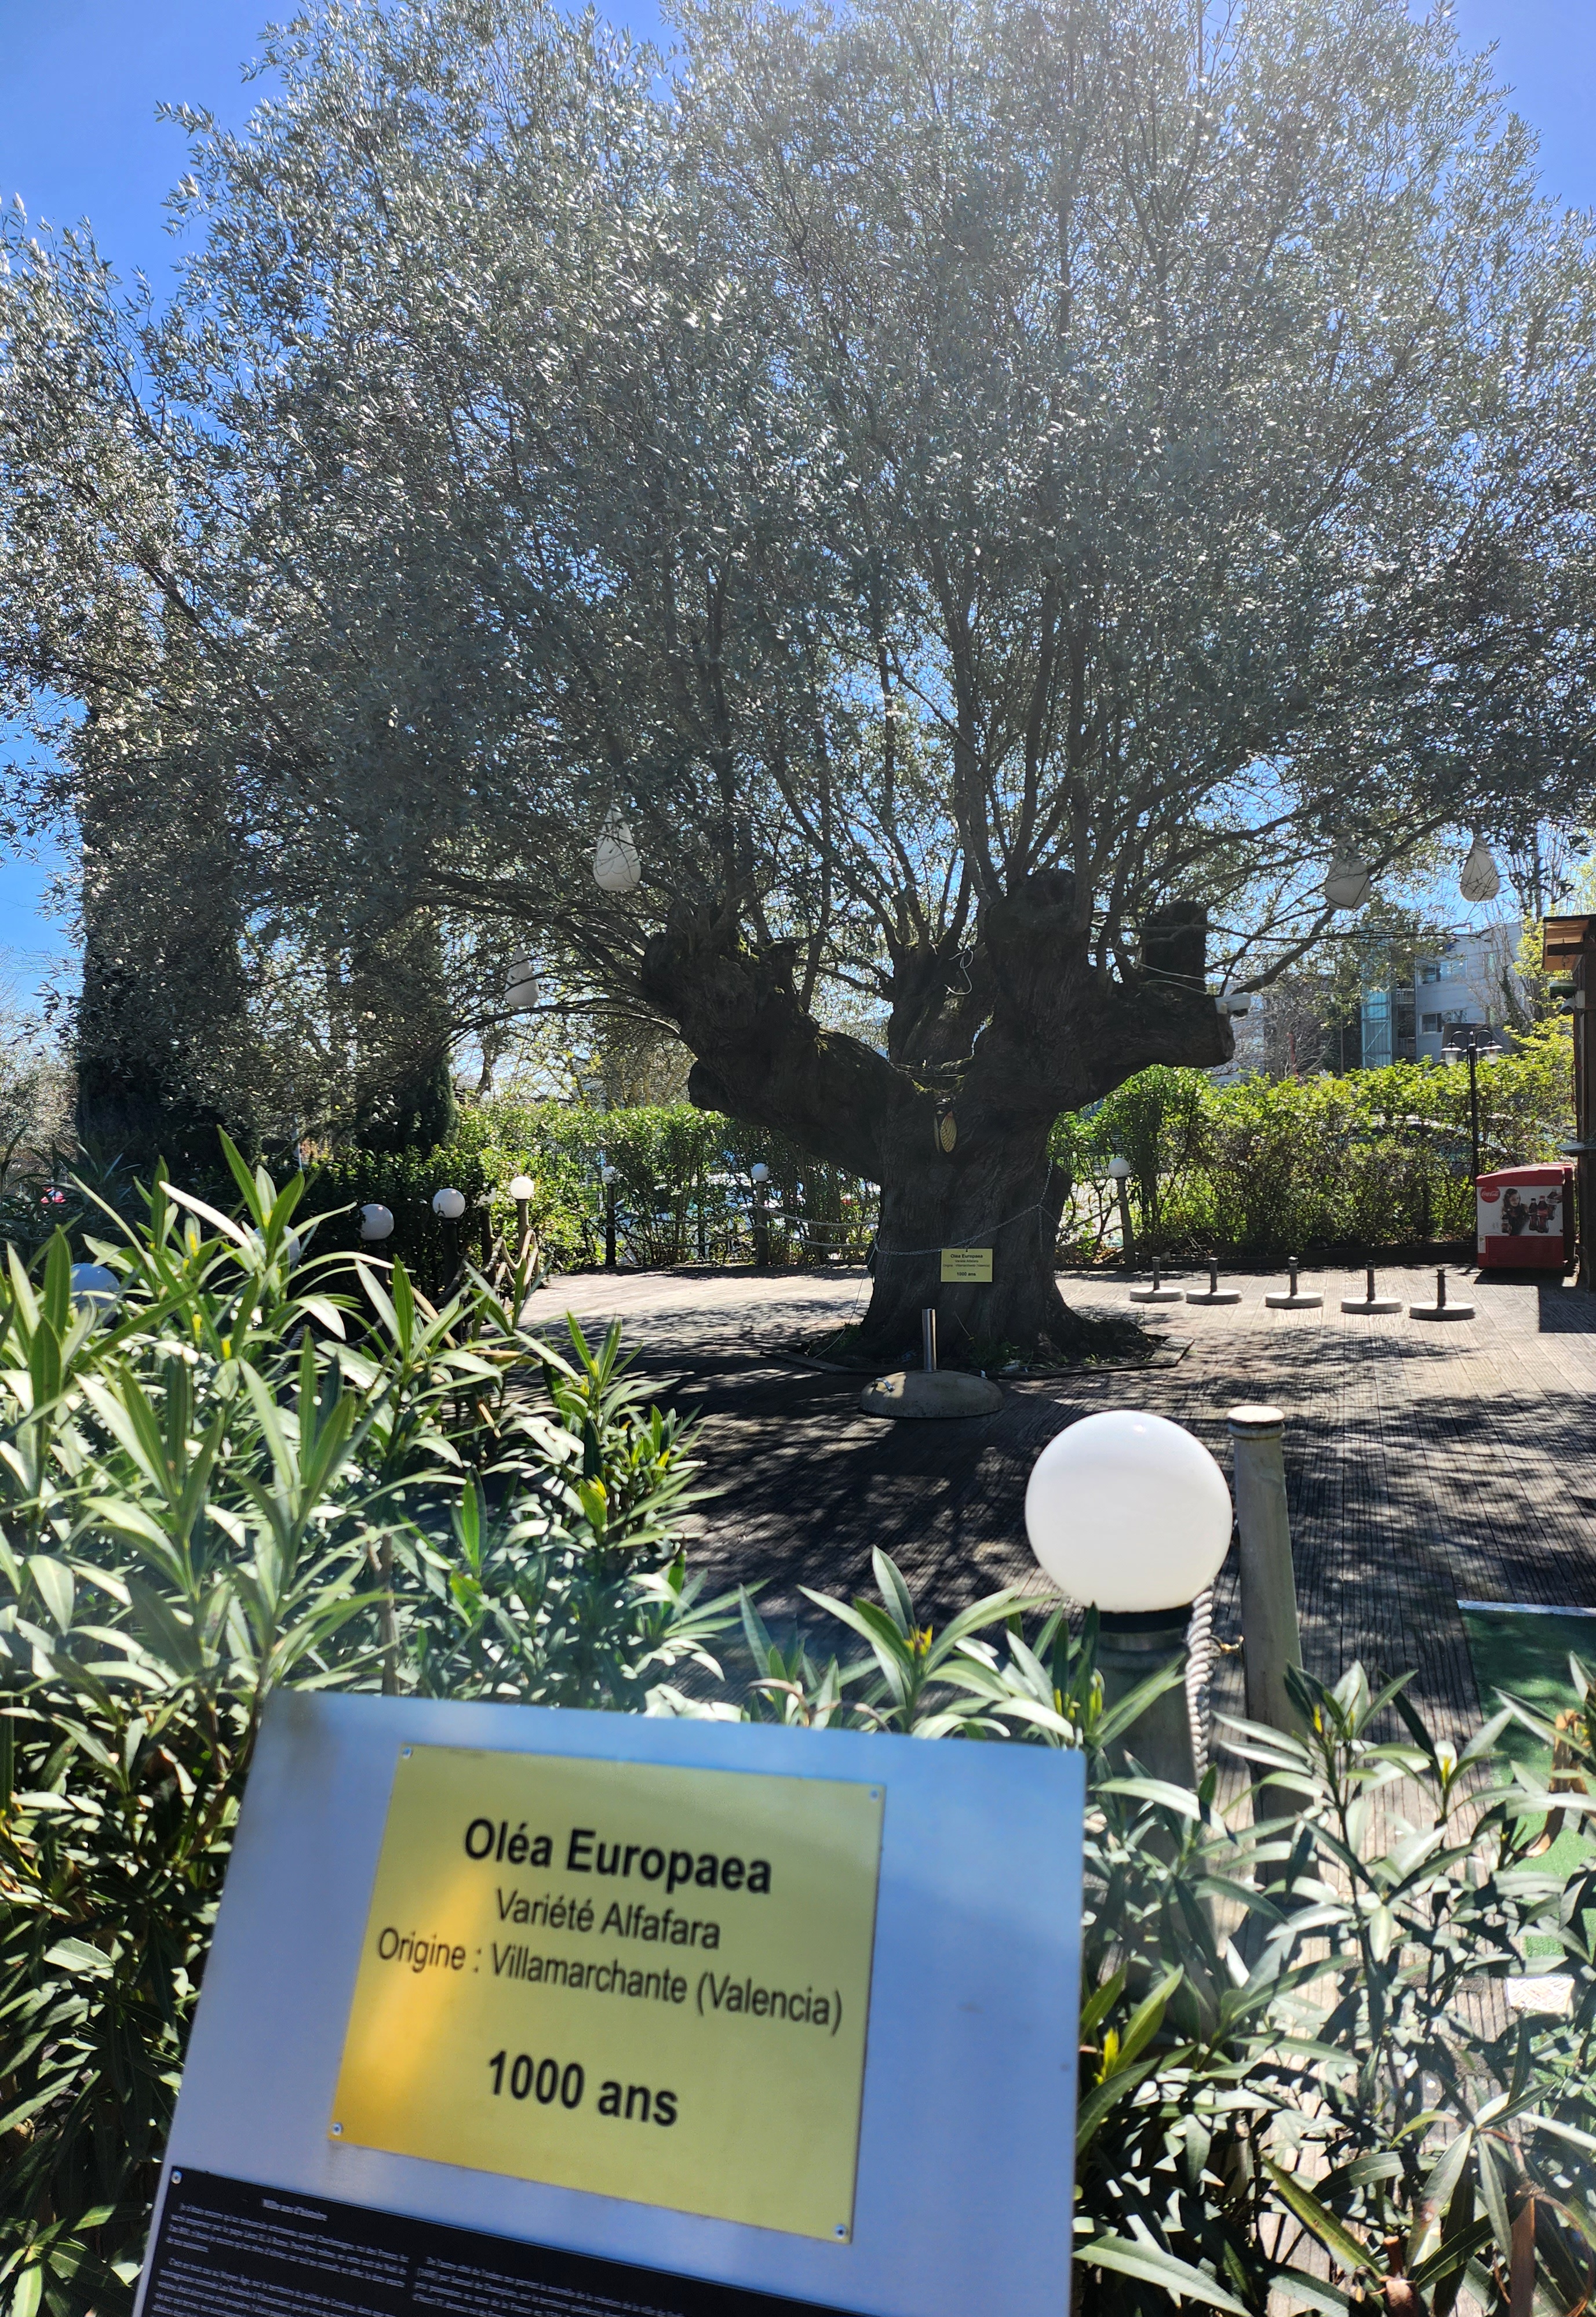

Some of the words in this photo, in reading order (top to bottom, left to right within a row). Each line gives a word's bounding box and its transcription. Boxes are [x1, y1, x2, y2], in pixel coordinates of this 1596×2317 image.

[464, 1817, 554, 1868] Oléa
[566, 1827, 773, 1895] Europaea
[496, 1887, 595, 1933] Variété
[600, 1901, 721, 1950] Alfafara
[378, 1927, 466, 1973] Origine
[491, 1942, 688, 2004] Villamarchante
[696, 1972, 843, 2036] (Valencia)
[488, 2049, 586, 2110] 1000
[597, 2080, 679, 2127] ans
